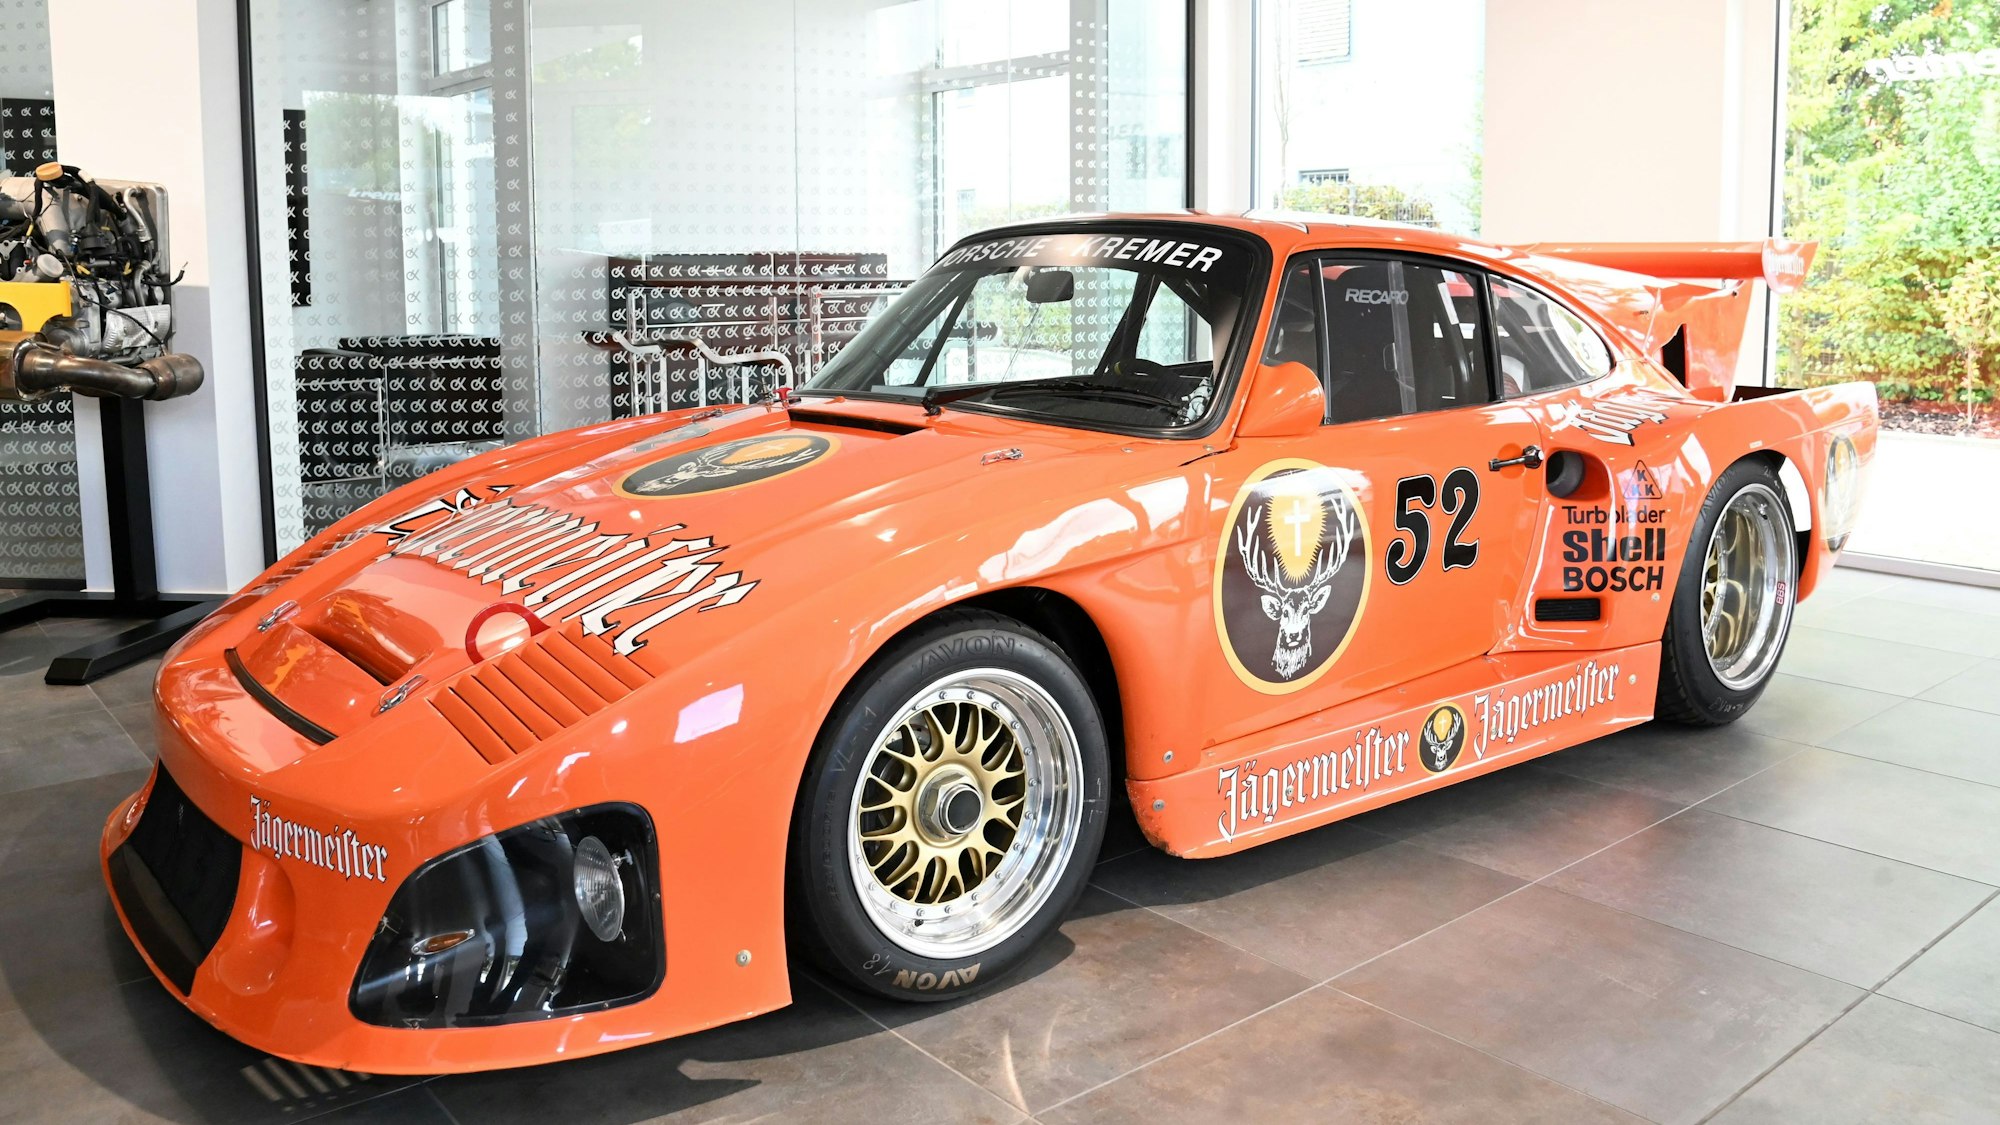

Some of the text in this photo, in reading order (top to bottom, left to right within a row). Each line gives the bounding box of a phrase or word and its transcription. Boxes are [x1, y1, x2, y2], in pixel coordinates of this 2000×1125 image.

[941, 238, 1054, 267] ORSCHE
[1072, 237, 1223, 273] KREMER
[1344, 288, 1409, 305] RECARO
[1385, 466, 1481, 586] 52
[1562, 505, 1665, 524] Turbolader
[1562, 528, 1666, 562] Shell
[1563, 566, 1664, 592] BOSCH
[1776, 582, 1786, 605] BBS
[918, 634, 1016, 675] AVON
[891, 962, 982, 990] AVON
